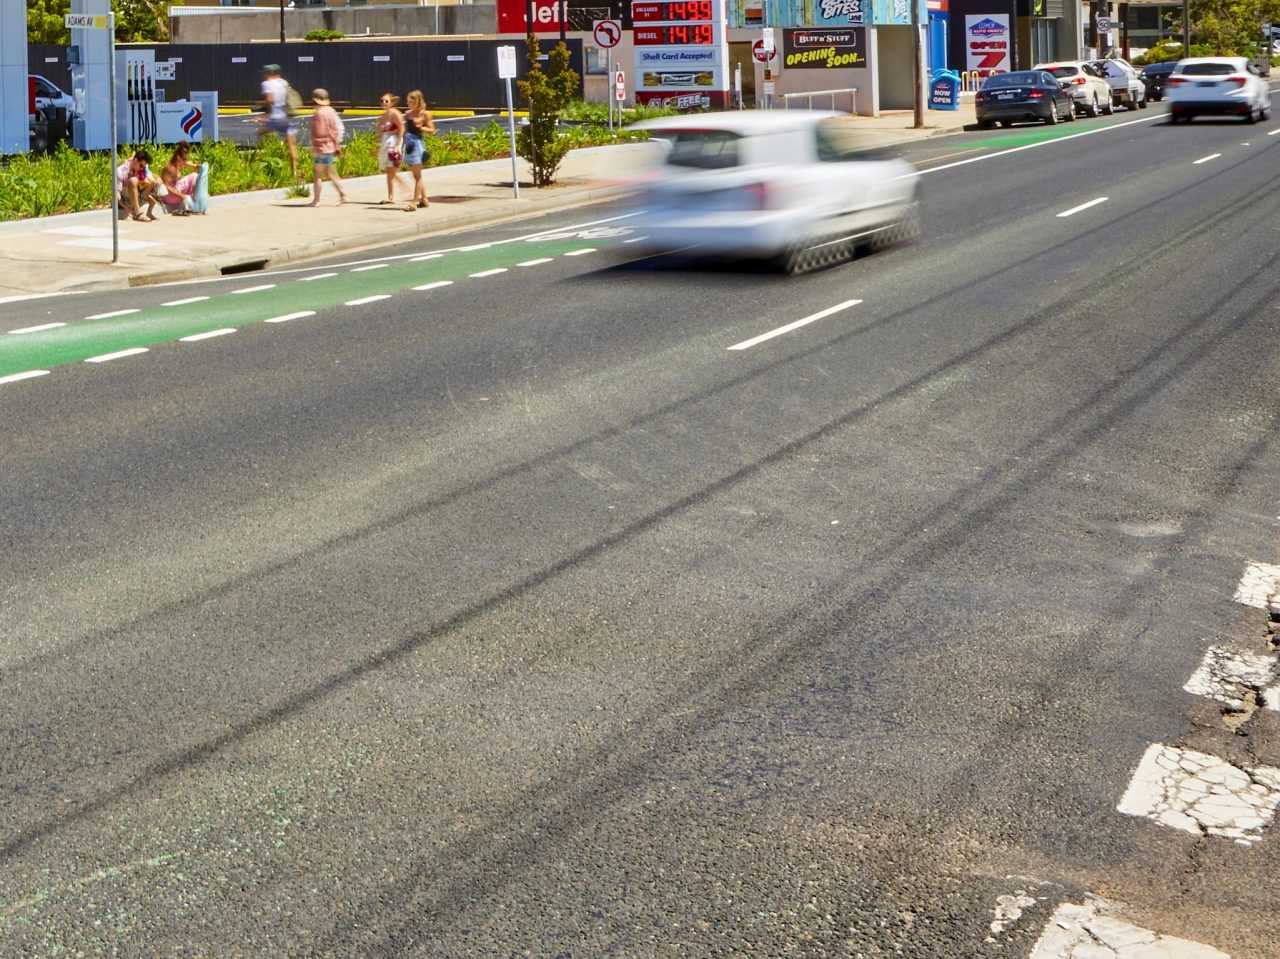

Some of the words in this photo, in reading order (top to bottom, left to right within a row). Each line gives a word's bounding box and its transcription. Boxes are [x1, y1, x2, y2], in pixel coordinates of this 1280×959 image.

[823, 0, 860, 19] BITES
[637, 32, 657, 40] DIESEL
[970, 41, 1007, 50] OPEN
[642, 52, 660, 60] Shell
[661, 52, 679, 60] Card
[680, 52, 713, 61] Accepted
[786, 47, 836, 65] OPENING
[971, 51, 1006, 68] 7
